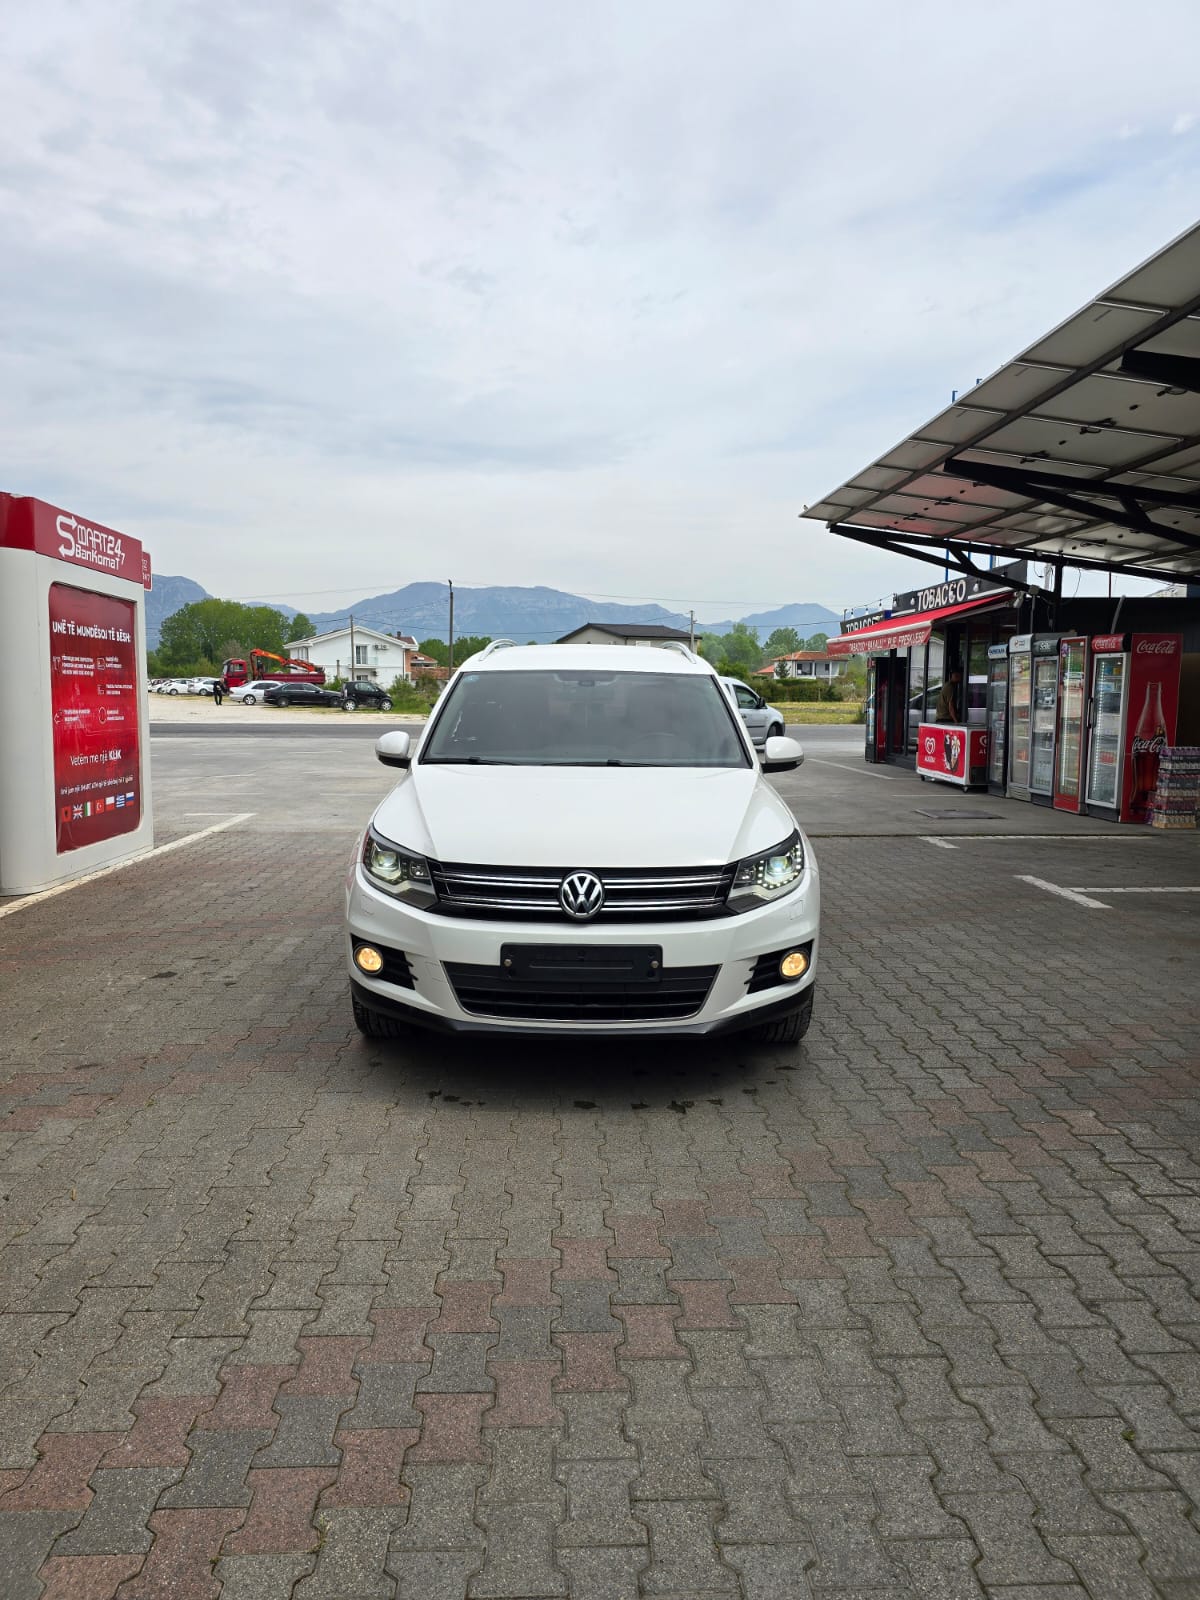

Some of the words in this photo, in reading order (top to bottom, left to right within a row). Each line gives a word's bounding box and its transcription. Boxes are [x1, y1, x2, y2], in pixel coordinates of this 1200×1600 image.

[917, 579, 966, 611] TOBACCO
[52, 619, 66, 634] UNË
[67, 620, 75, 636] TË
[1136, 640, 1176, 654] Coca-Cola
[70, 753, 88, 766] Vetëm
[90, 755, 99, 764] me
